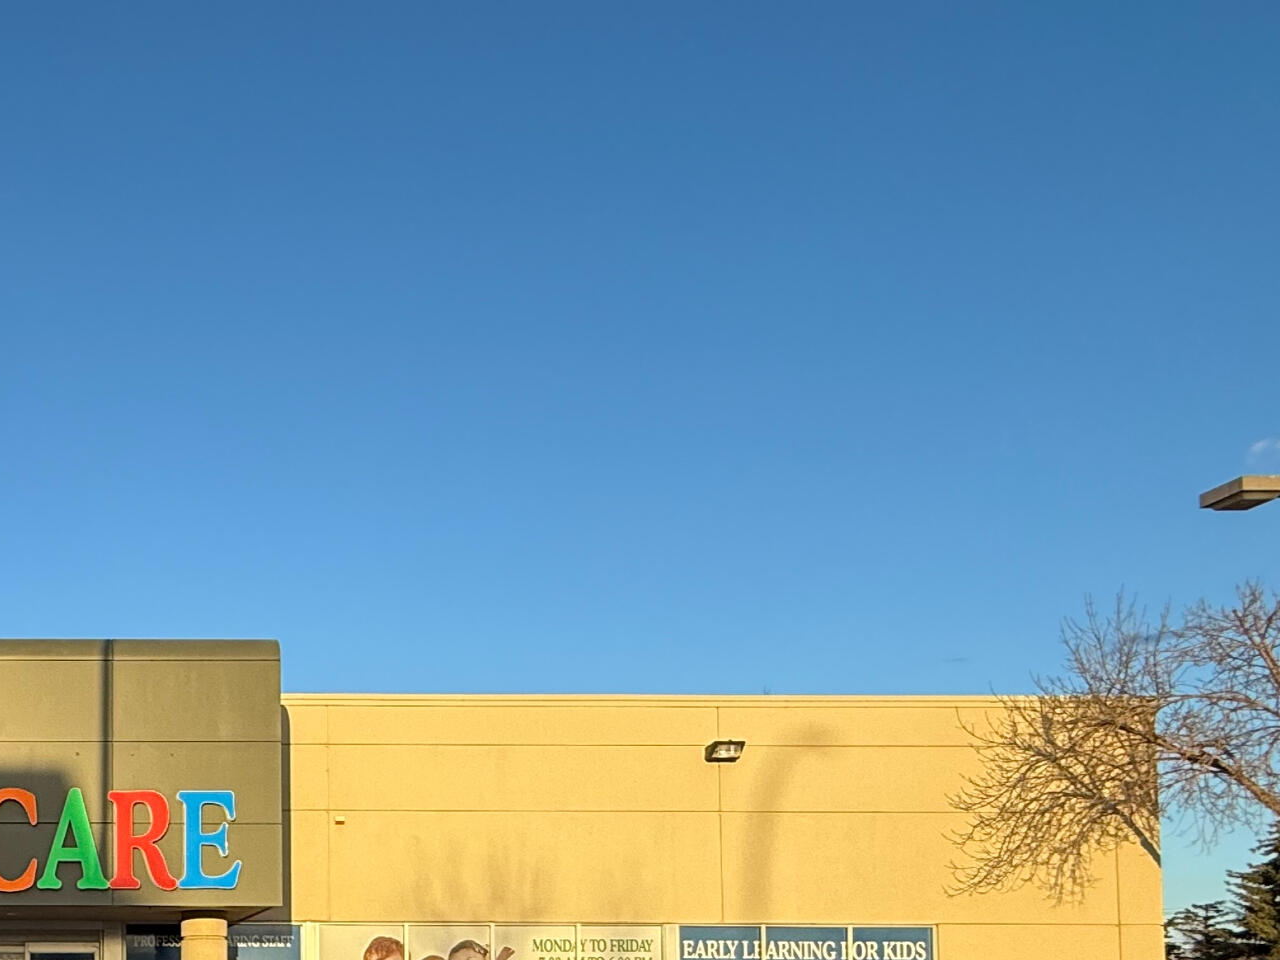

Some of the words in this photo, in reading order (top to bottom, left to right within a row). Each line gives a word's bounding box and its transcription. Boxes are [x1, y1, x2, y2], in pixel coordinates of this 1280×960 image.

[133, 934, 182, 948] PROFESS
[227, 935, 260, 948] ARING
[262, 935, 294, 948] STAFF
[589, 938, 607, 953] TO
[609, 938, 654, 953] FRIDAY
[682, 940, 739, 960] EARLY
[883, 941, 927, 960] KIDS
